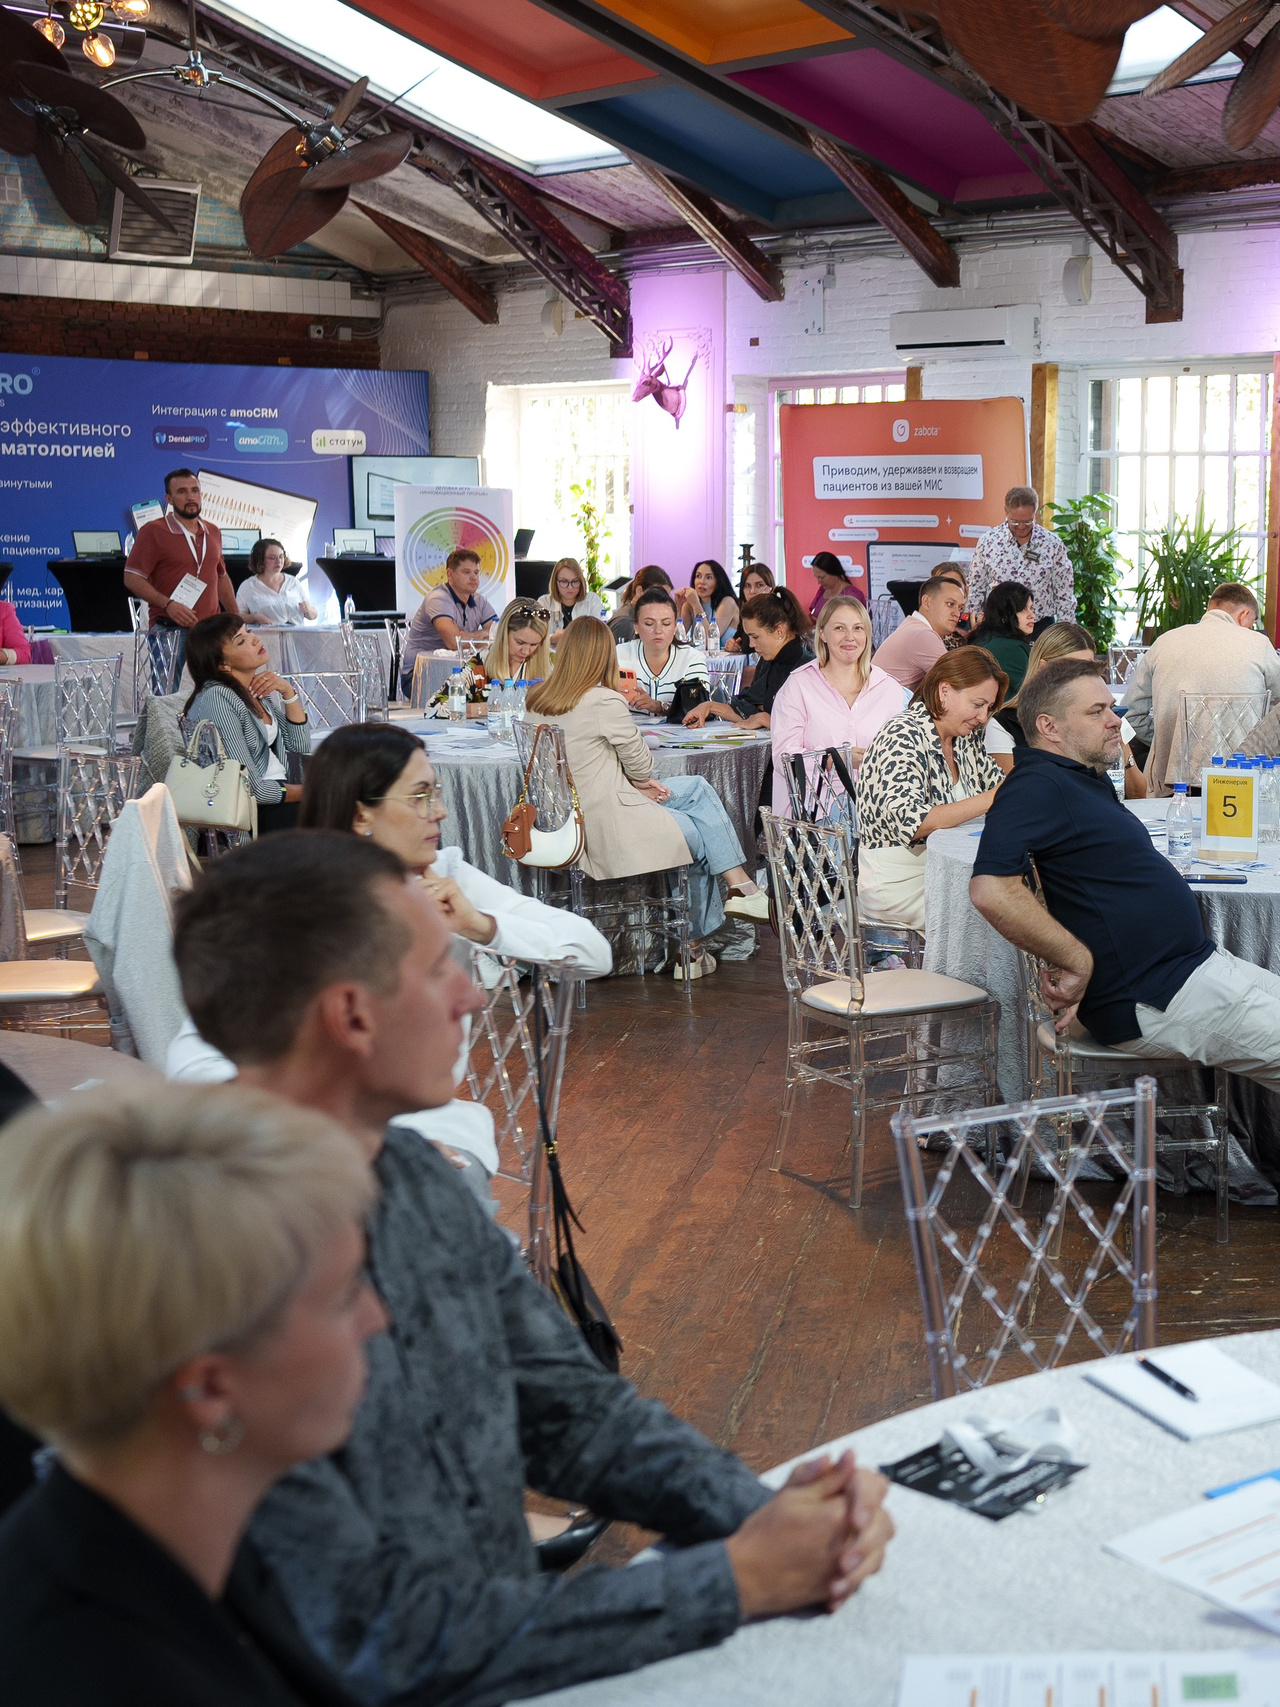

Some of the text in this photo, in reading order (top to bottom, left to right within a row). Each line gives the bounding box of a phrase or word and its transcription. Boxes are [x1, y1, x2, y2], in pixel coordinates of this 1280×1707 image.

[151, 405, 279, 419] Интеграция с amoCRM
[1, 418, 131, 437] эффективного
[914, 425, 939, 436] zabota
[329, 437, 363, 448] статум
[2, 442, 115, 458] матологией
[822, 464, 978, 479] Приводим, удерживаем и возвращаем
[823, 479, 943, 492] пациентов из вашей МИС
[2, 546, 60, 557] пациентов
[17, 587, 41, 597] мед.
[1213, 778, 1248, 787] Инженерия
[1222, 795, 1238, 818] 5
